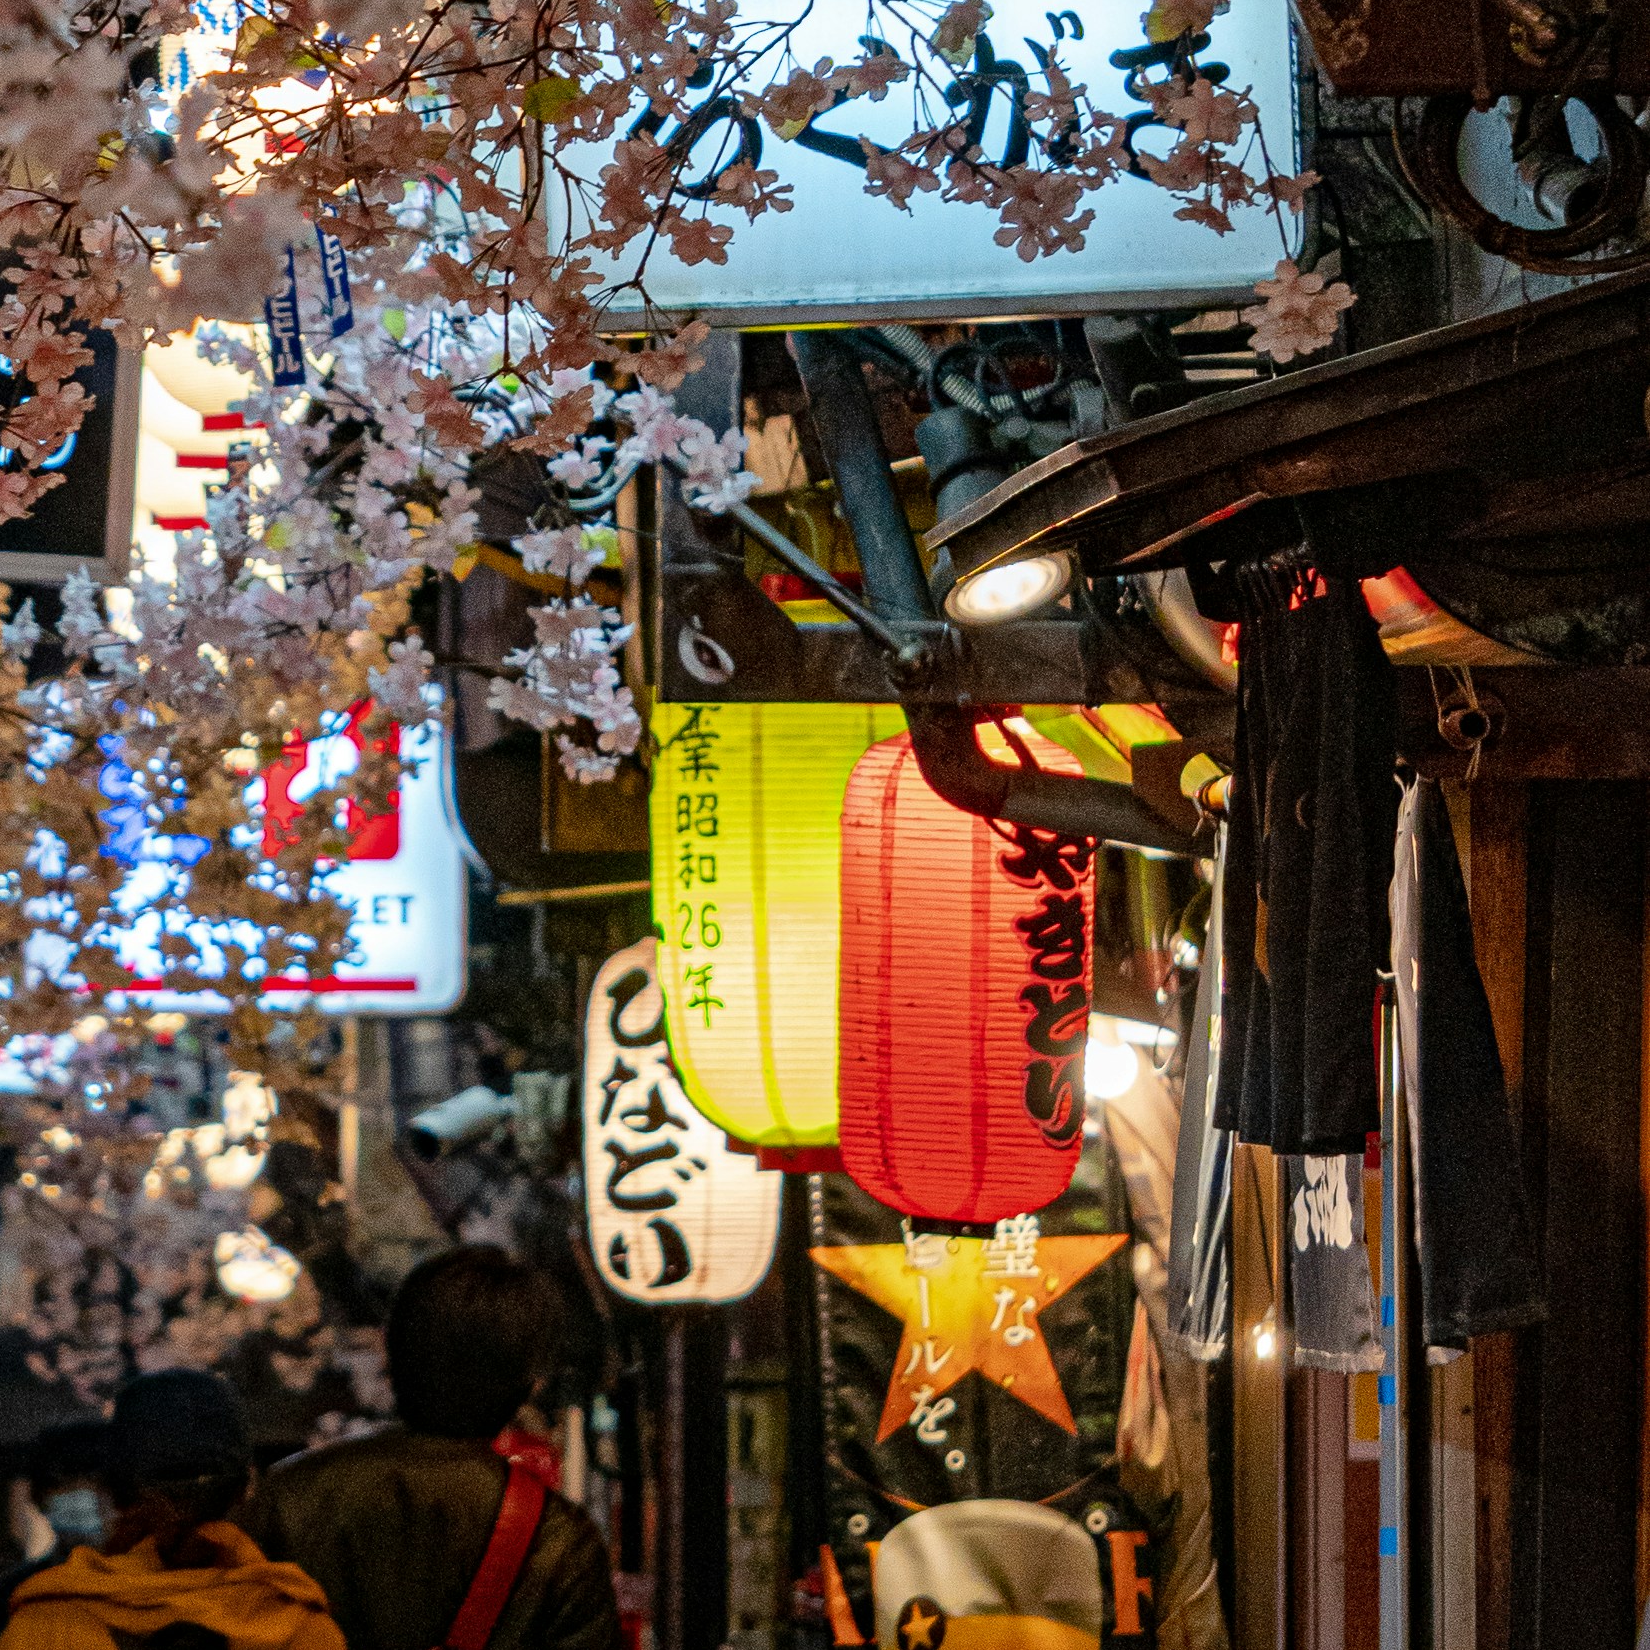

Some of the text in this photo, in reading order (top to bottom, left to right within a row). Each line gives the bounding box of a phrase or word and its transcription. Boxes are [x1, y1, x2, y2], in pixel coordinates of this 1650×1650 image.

[604, 966, 694, 1288] ひなどり
[996, 822, 1090, 1140] やきとり
